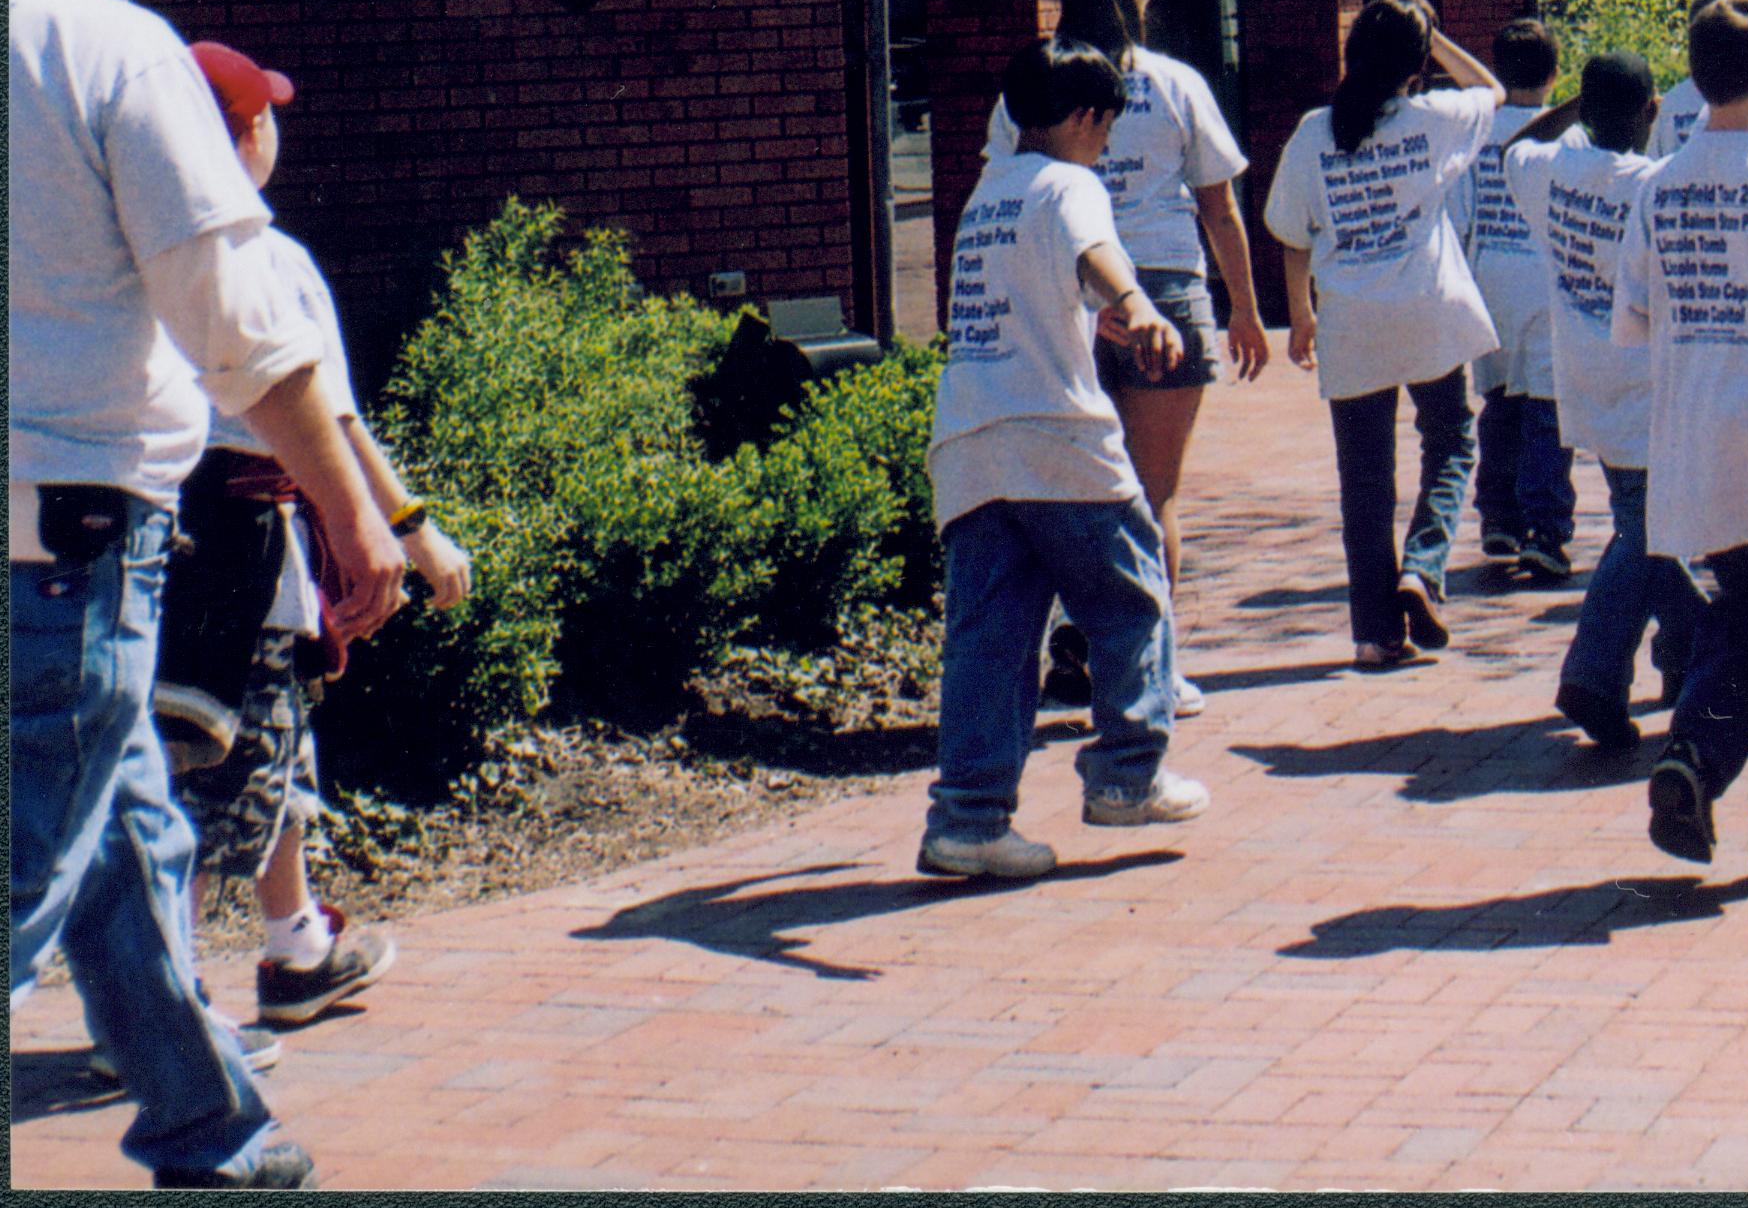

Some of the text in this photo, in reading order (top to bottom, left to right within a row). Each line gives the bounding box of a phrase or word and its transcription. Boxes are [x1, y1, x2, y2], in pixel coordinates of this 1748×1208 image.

[1376, 143, 1400, 159] Tour
[1325, 174, 1347, 188] New
[1348, 170, 1379, 185] Salem
[1381, 163, 1408, 180] State
[1328, 184, 1394, 207] Lincoln Tomb
[1332, 208, 1369, 225] Lincoln
[1654, 213, 1677, 232] New
[1679, 211, 1717, 231] Salem
[1656, 235, 1696, 254] Lincoln
[951, 301, 984, 320] State
[1679, 304, 1710, 324] State
